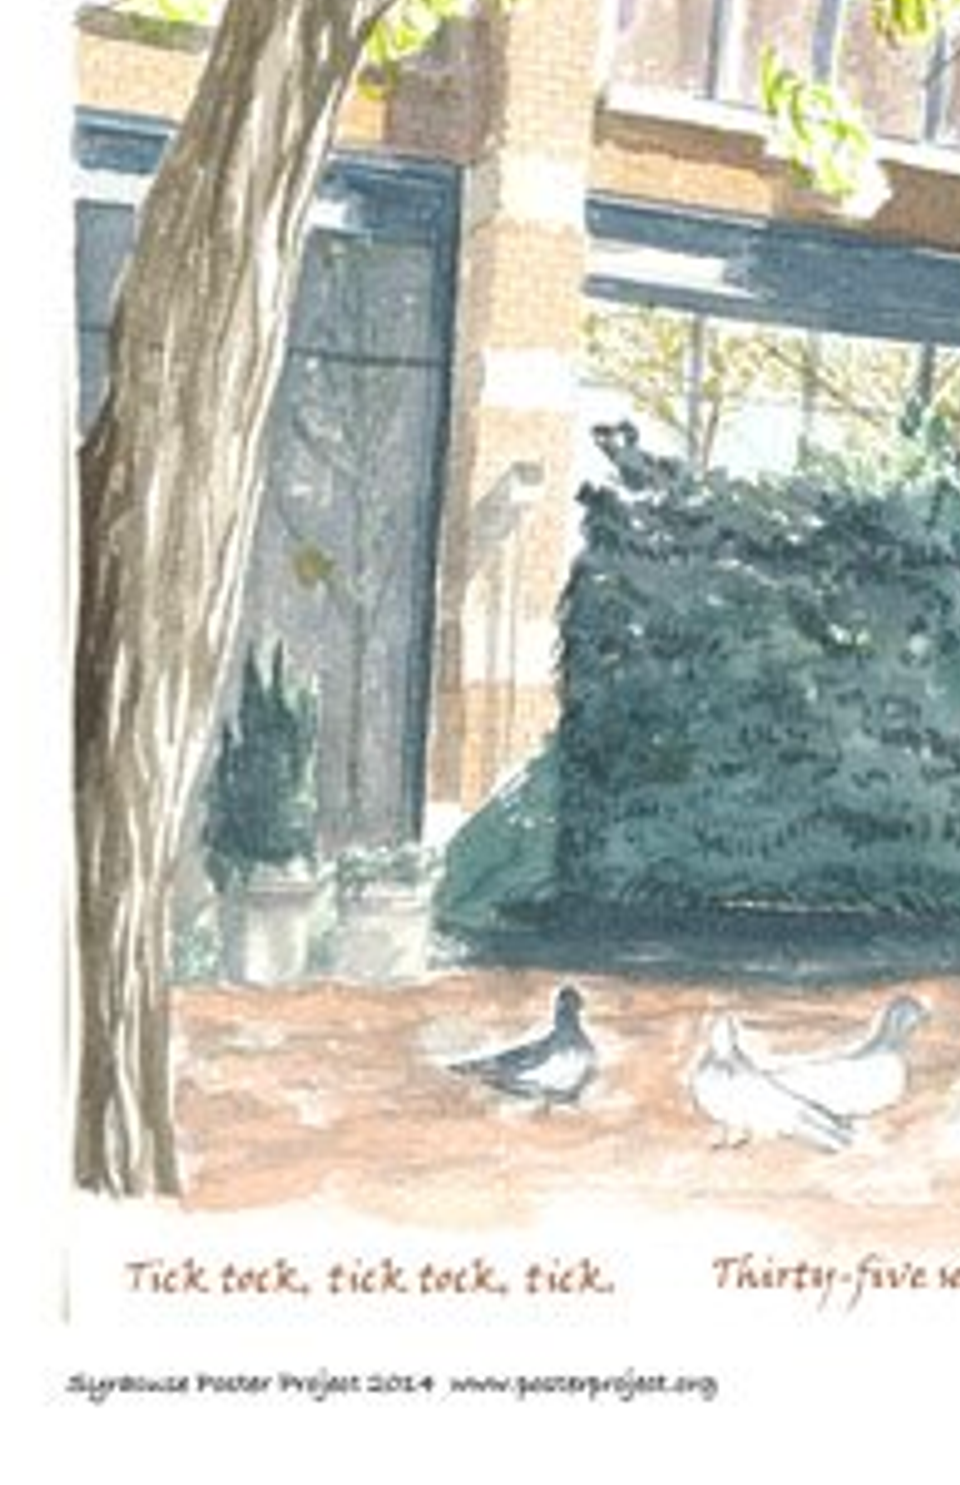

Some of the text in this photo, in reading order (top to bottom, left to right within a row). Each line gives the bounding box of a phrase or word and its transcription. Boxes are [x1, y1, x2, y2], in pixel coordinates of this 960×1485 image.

[126, 1257, 210, 1295] Tick
[328, 1257, 408, 1295] tick
[525, 1257, 616, 1295] tick.
[712, 1252, 928, 1313] Thirty-five
[66, 1367, 719, 1405] Syracuse Poster Project 2014 www.posterproject.org
